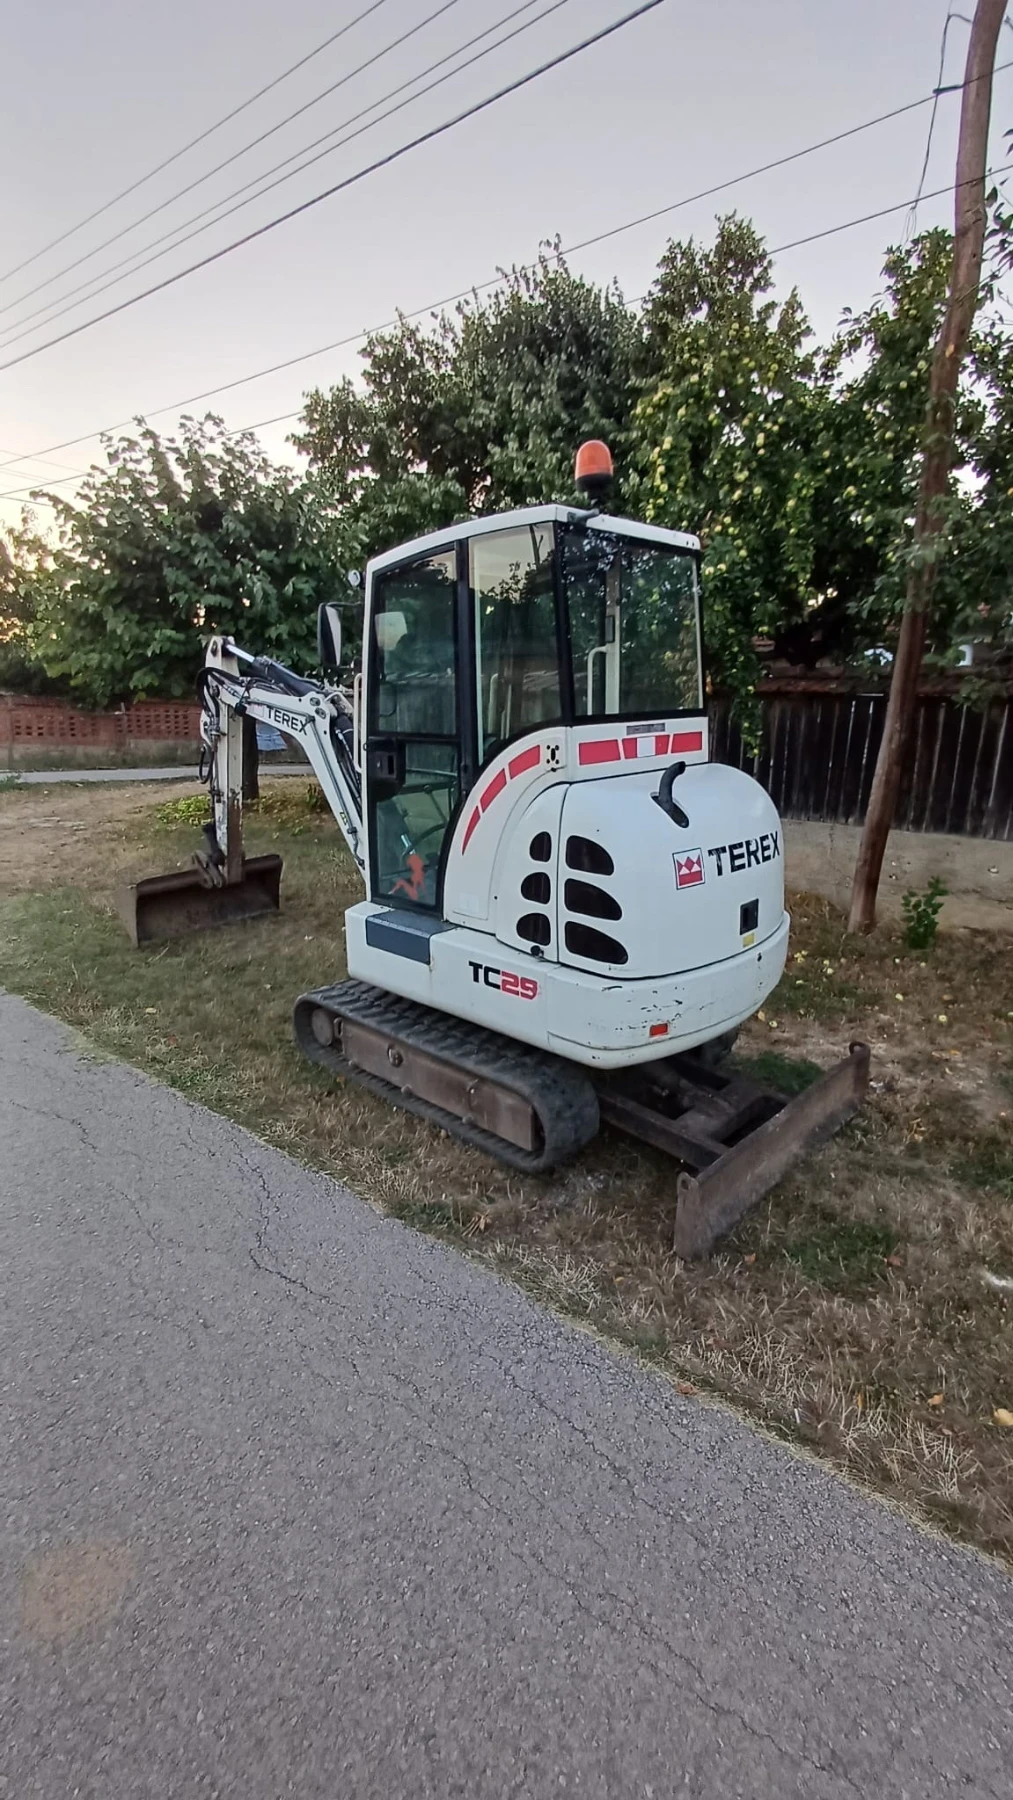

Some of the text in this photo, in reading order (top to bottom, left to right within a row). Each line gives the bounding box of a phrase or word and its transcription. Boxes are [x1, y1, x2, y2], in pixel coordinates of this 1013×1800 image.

[266, 705, 307, 735] TEREX
[708, 831, 780, 876] TEREX
[468, 961, 538, 1000] TC29
